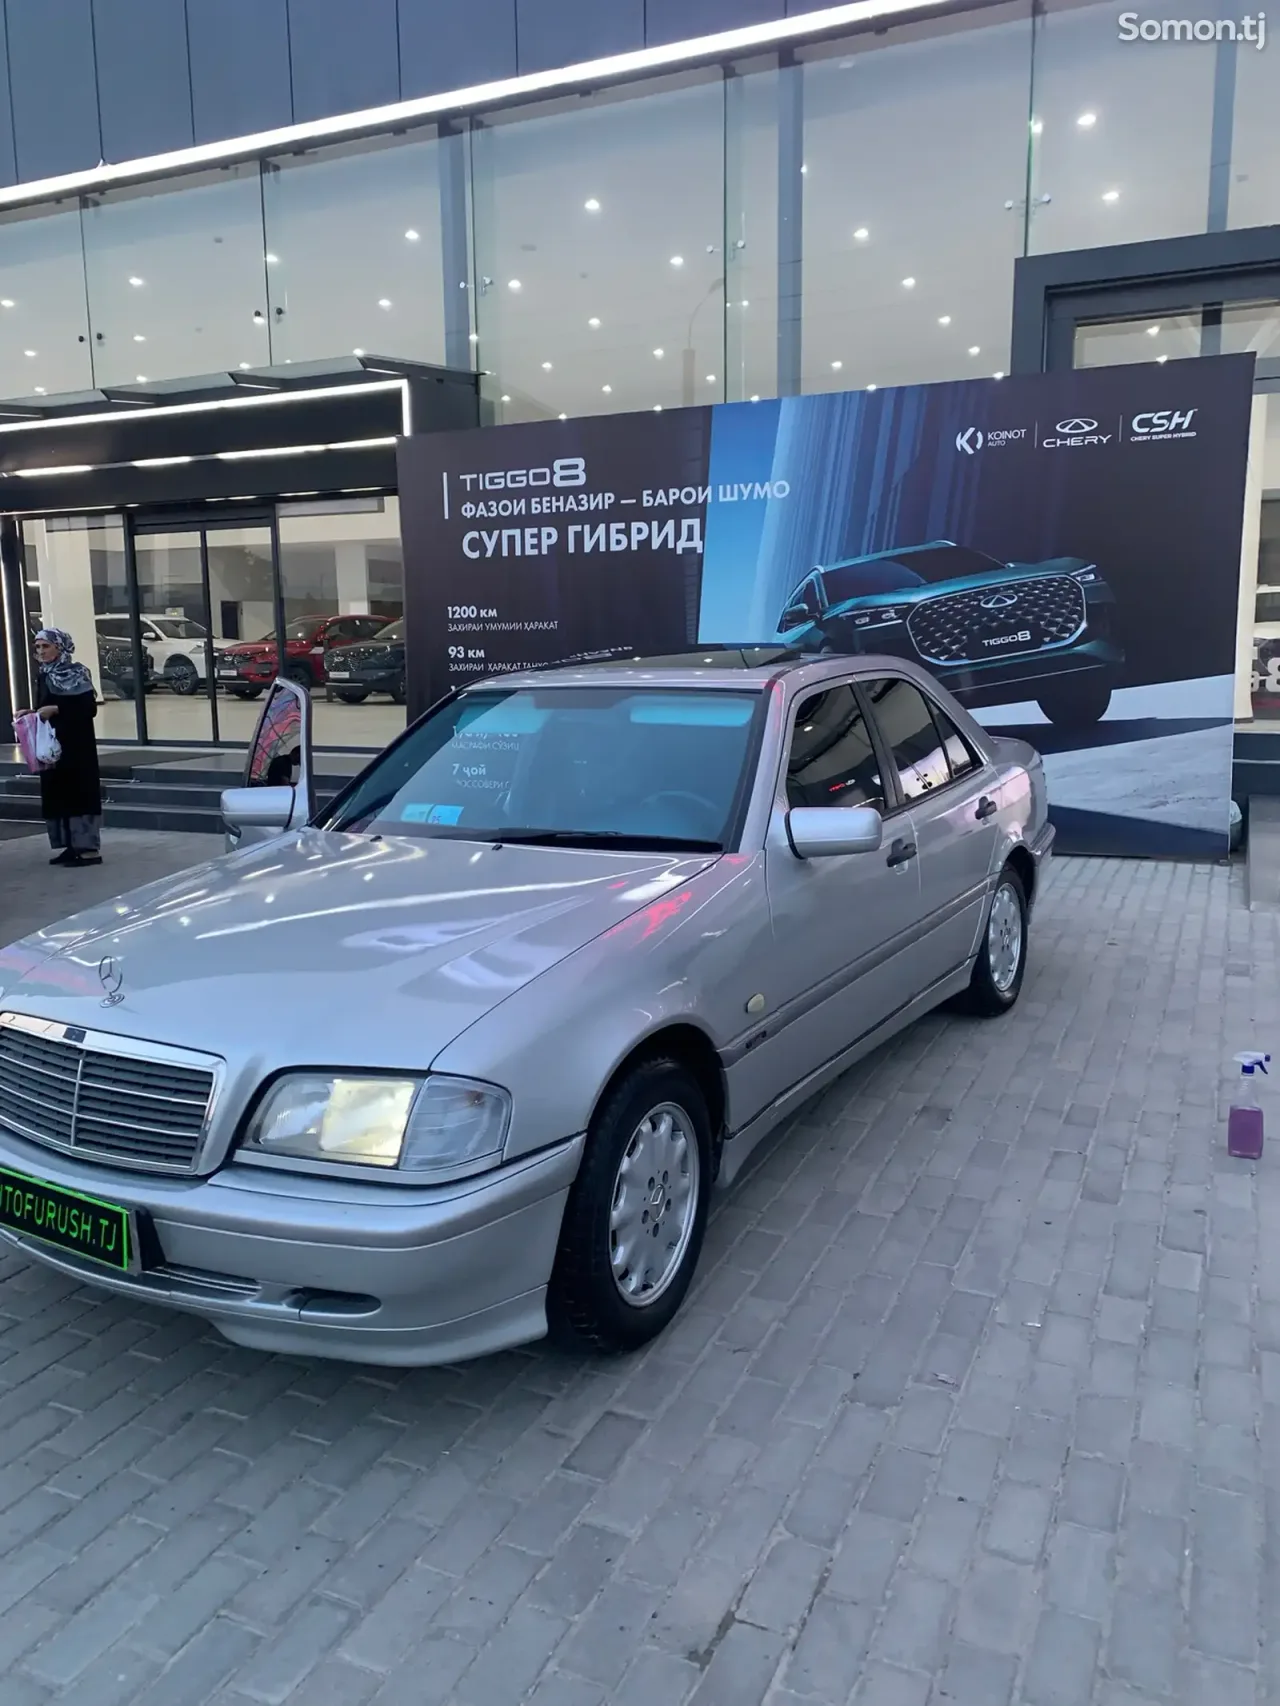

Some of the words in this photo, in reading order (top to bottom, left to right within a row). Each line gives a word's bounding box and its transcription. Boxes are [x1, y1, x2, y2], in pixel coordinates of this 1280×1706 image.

[1132, 409, 1195, 433] CSH
[987, 429, 1027, 441] KOINOT
[1042, 434, 1113, 448] CHERY
[461, 499, 526, 519] ФАЗОИ
[531, 492, 616, 515] БЕНАЗИР
[642, 486, 713, 508] БАРОИ
[718, 479, 791, 502] ШУМО
[462, 526, 559, 560] СУПЕР
[567, 517, 704, 555] ГИБРИД
[447, 606, 477, 619] 1200
[448, 646, 466, 659] 93
[452, 763, 460, 775] 7
